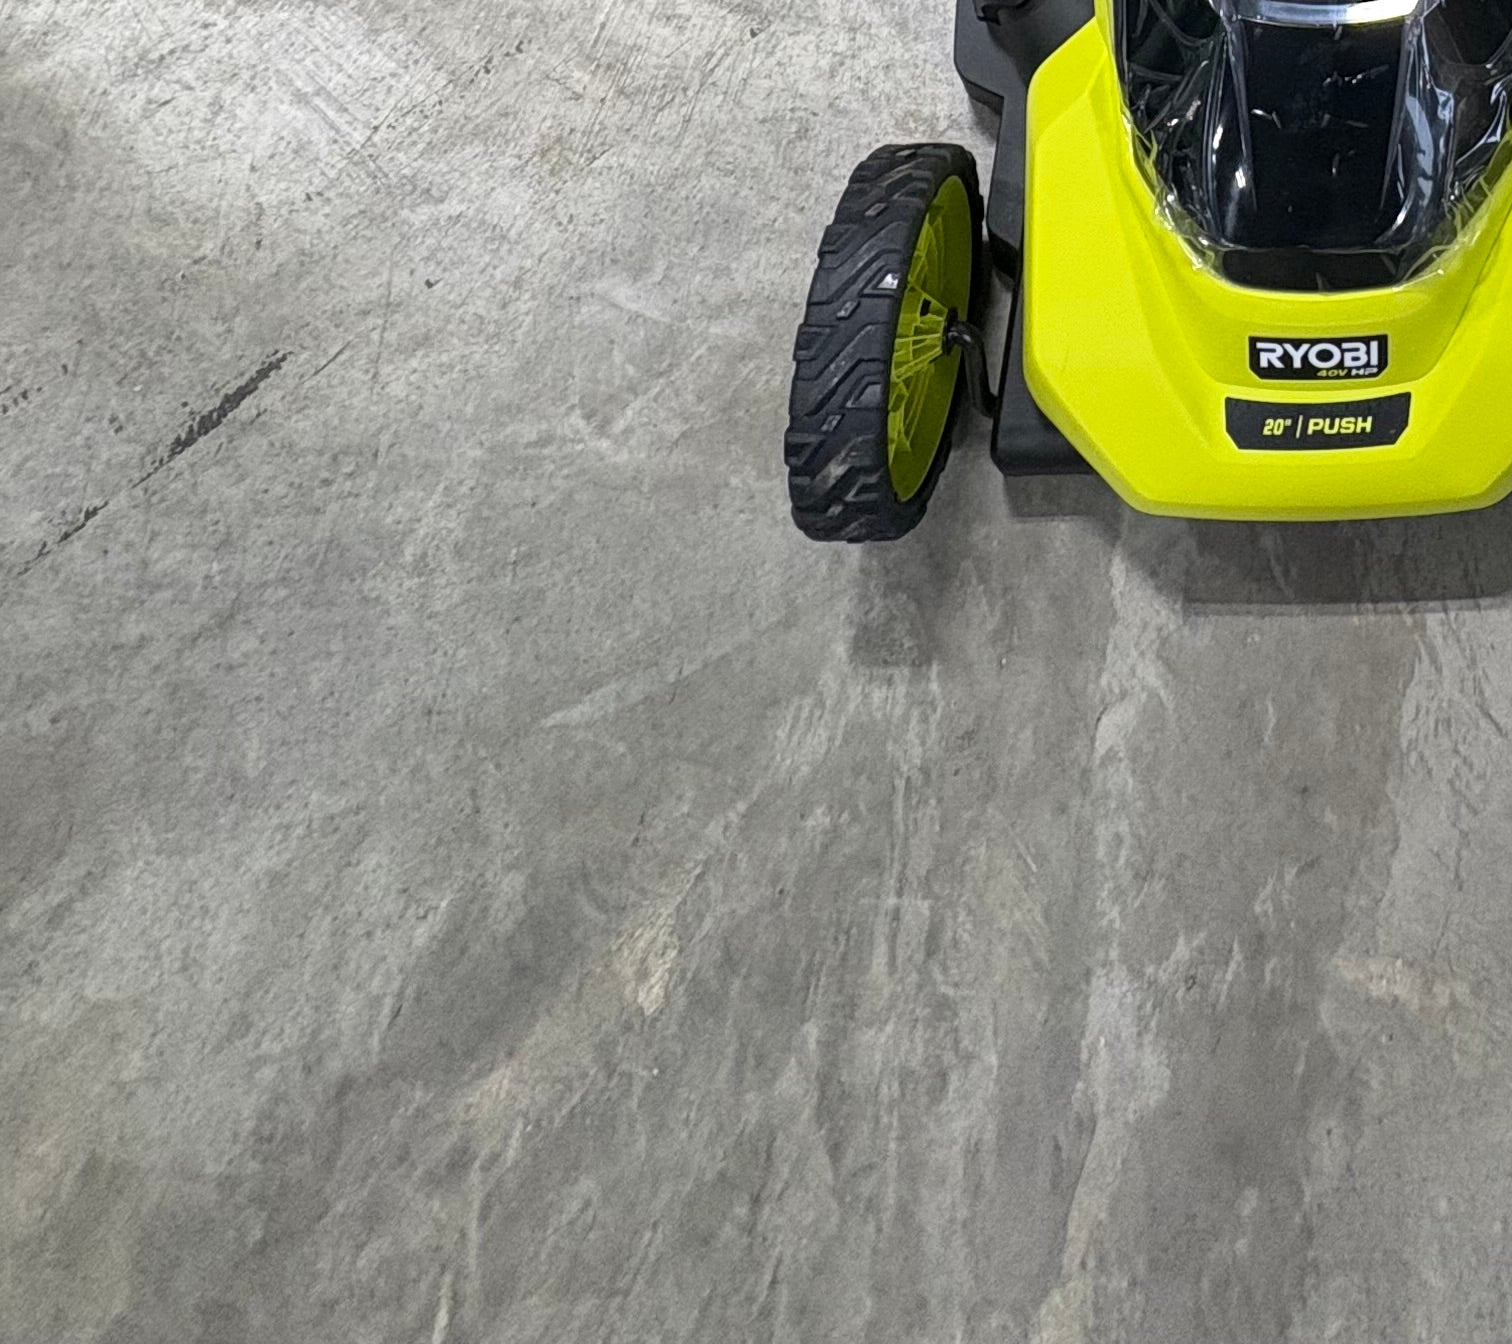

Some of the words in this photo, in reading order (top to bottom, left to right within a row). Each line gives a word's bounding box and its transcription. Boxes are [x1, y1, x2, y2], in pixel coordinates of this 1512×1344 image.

[1256, 340, 1379, 369] RYOBI
[1316, 369, 1349, 377] 40V
[1350, 367, 1379, 376] HP
[1262, 418, 1292, 436] 20"
[1306, 416, 1373, 435] PUSH
